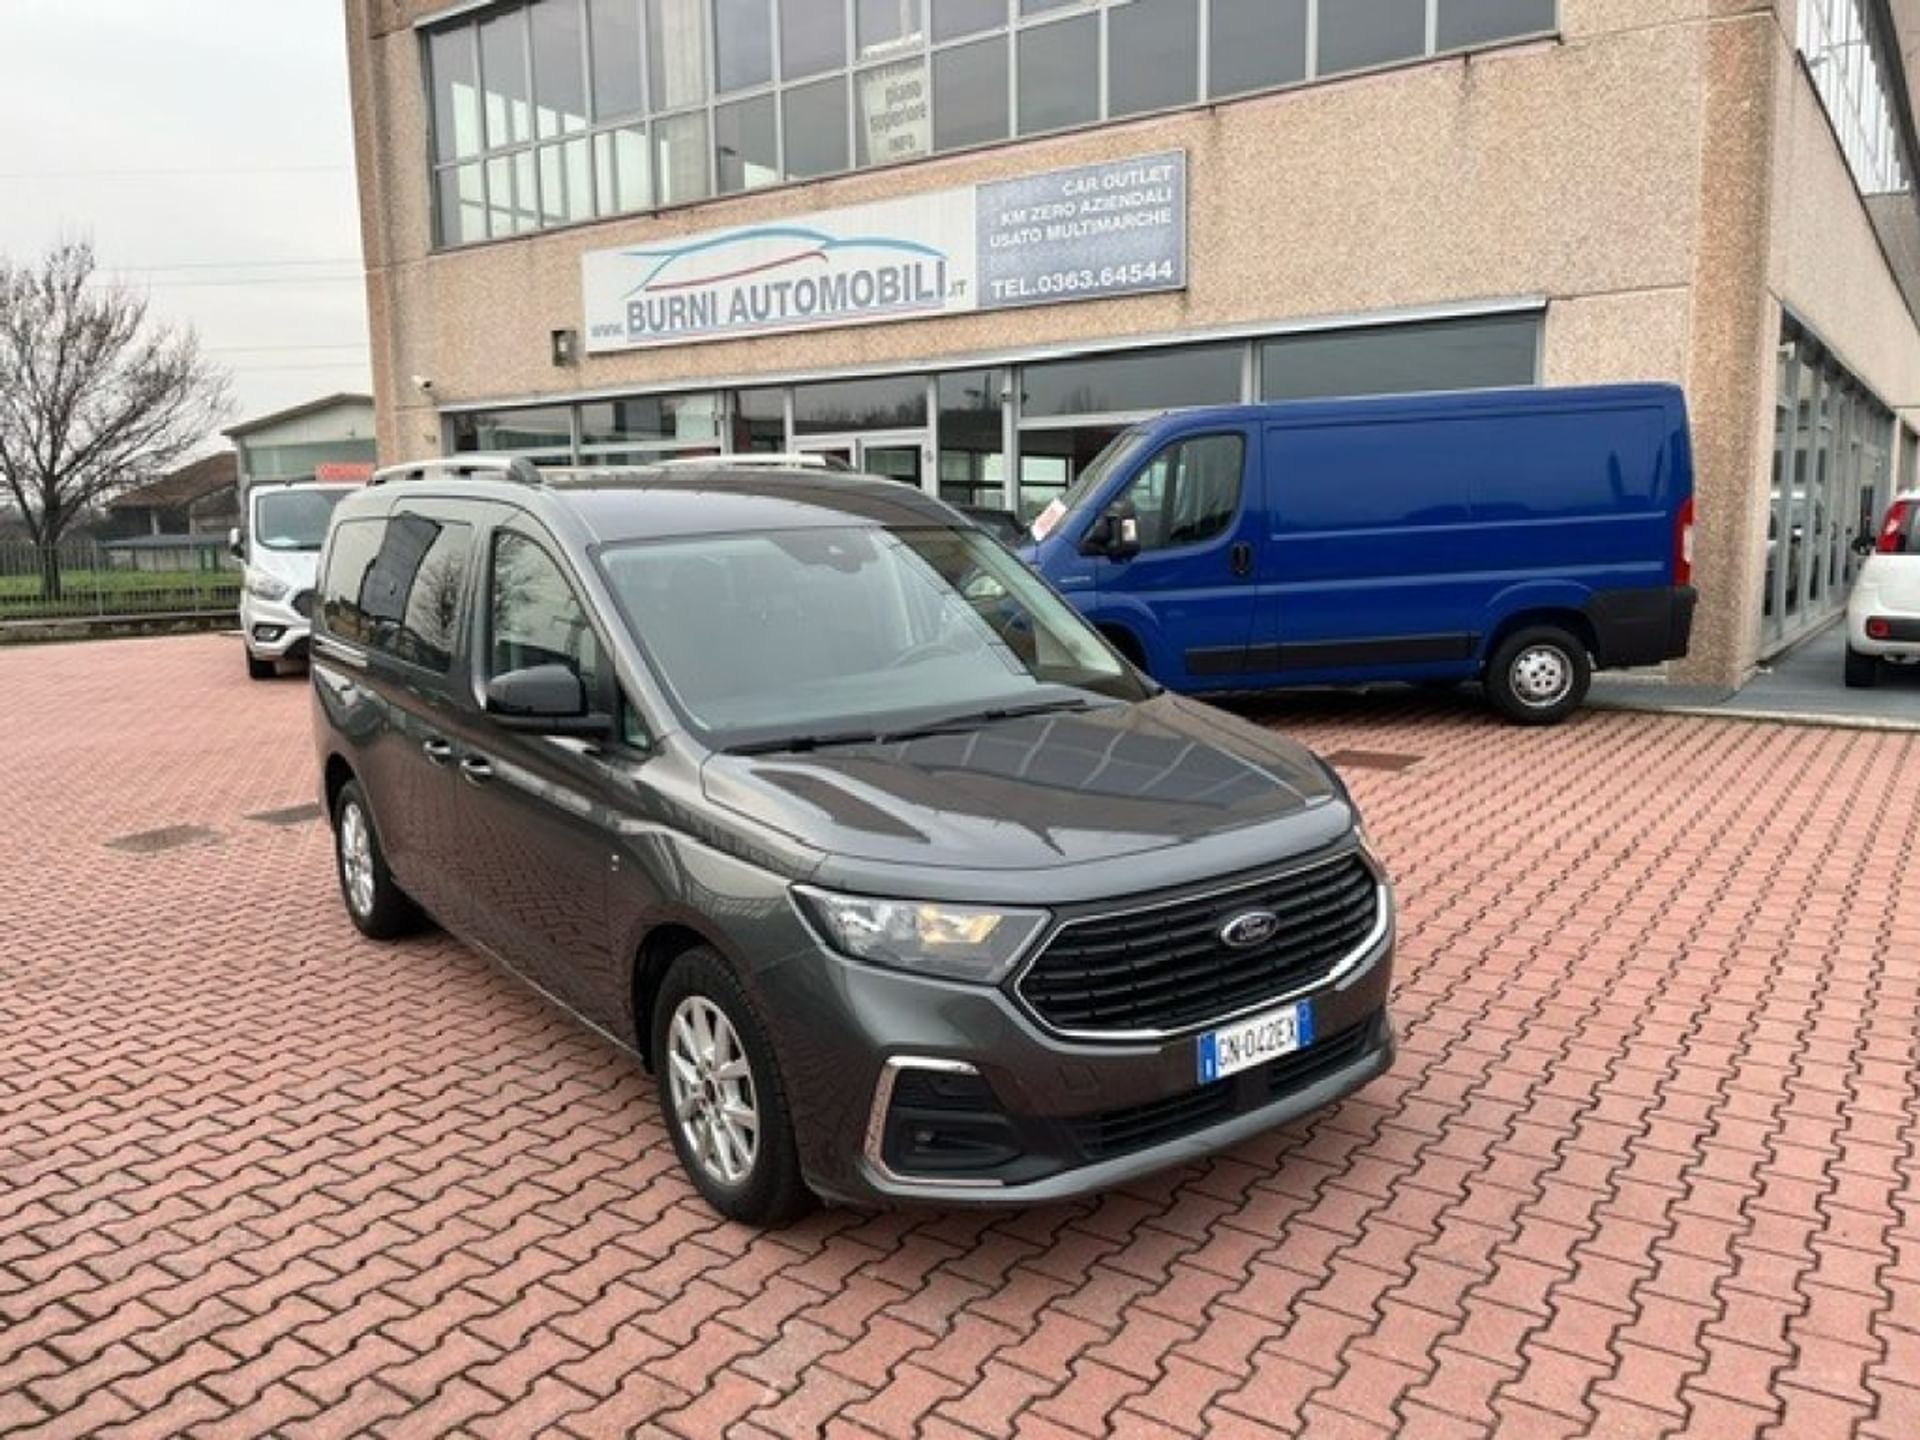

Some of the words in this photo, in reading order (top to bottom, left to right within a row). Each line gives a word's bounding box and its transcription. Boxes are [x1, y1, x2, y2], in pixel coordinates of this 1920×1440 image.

[1062, 177, 1099, 196] CAR
[1104, 165, 1175, 188] OUTLET
[1002, 209, 1026, 226] KM
[1031, 203, 1076, 221] ZERO
[1080, 187, 1172, 214] AZIENDALI
[989, 227, 1042, 248] USATO
[1046, 207, 1172, 241] MULTIMARCHE
[627, 291, 718, 333] BURNI
[730, 260, 946, 323] AUTOMOBILI
